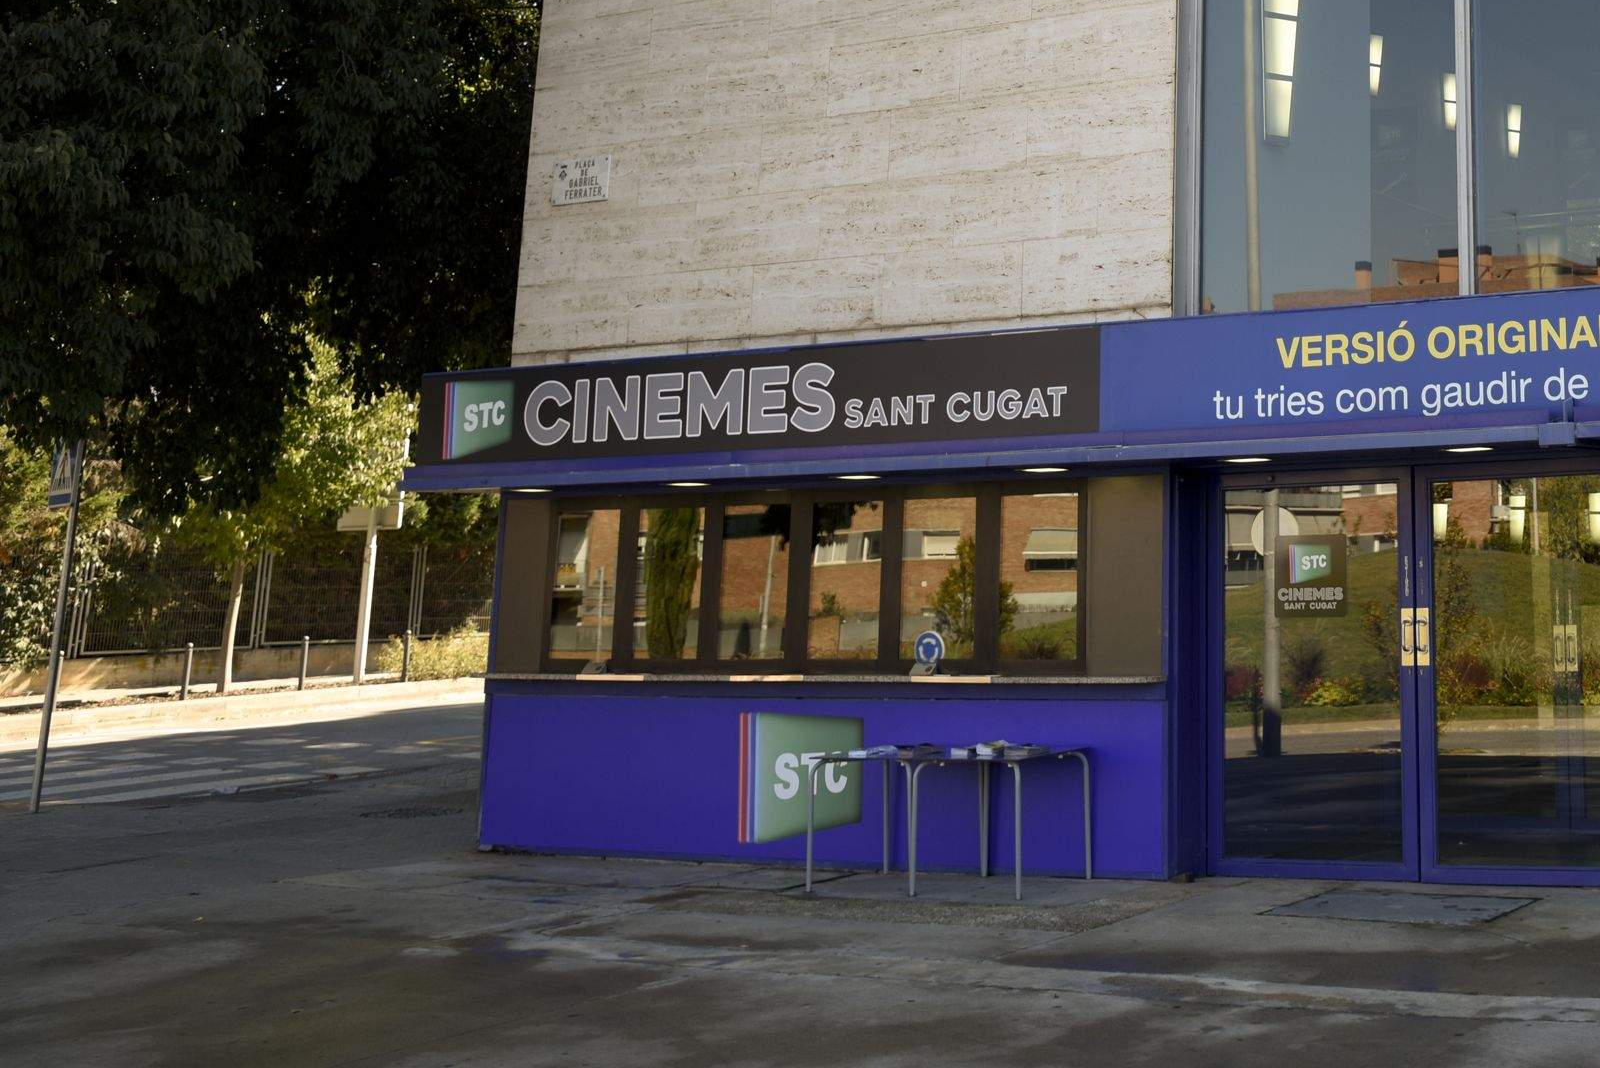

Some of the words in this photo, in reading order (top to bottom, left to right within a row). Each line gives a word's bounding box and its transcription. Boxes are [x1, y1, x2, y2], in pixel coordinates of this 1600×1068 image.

[565, 186, 602, 200] FERRATER
[569, 176, 599, 188] GABRIEL
[1276, 321, 1415, 369] VERSIÓ
[524, 363, 835, 446] CINEMES
[844, 394, 935, 428] SANT
[946, 386, 1067, 423] CUGAT
[1213, 390, 1243, 419] tu
[1255, 385, 1325, 418] tries
[1335, 384, 1408, 413] com
[1421, 370, 1532, 417] gaudir
[1543, 367, 1590, 401] de
[463, 400, 506, 433] STC
[1301, 554, 1327, 570] STC
[1277, 587, 1344, 601] CINEMES
[1283, 602, 1306, 610] SANT
[1309, 601, 1338, 609] CUGAT
[774, 751, 848, 800] STC
